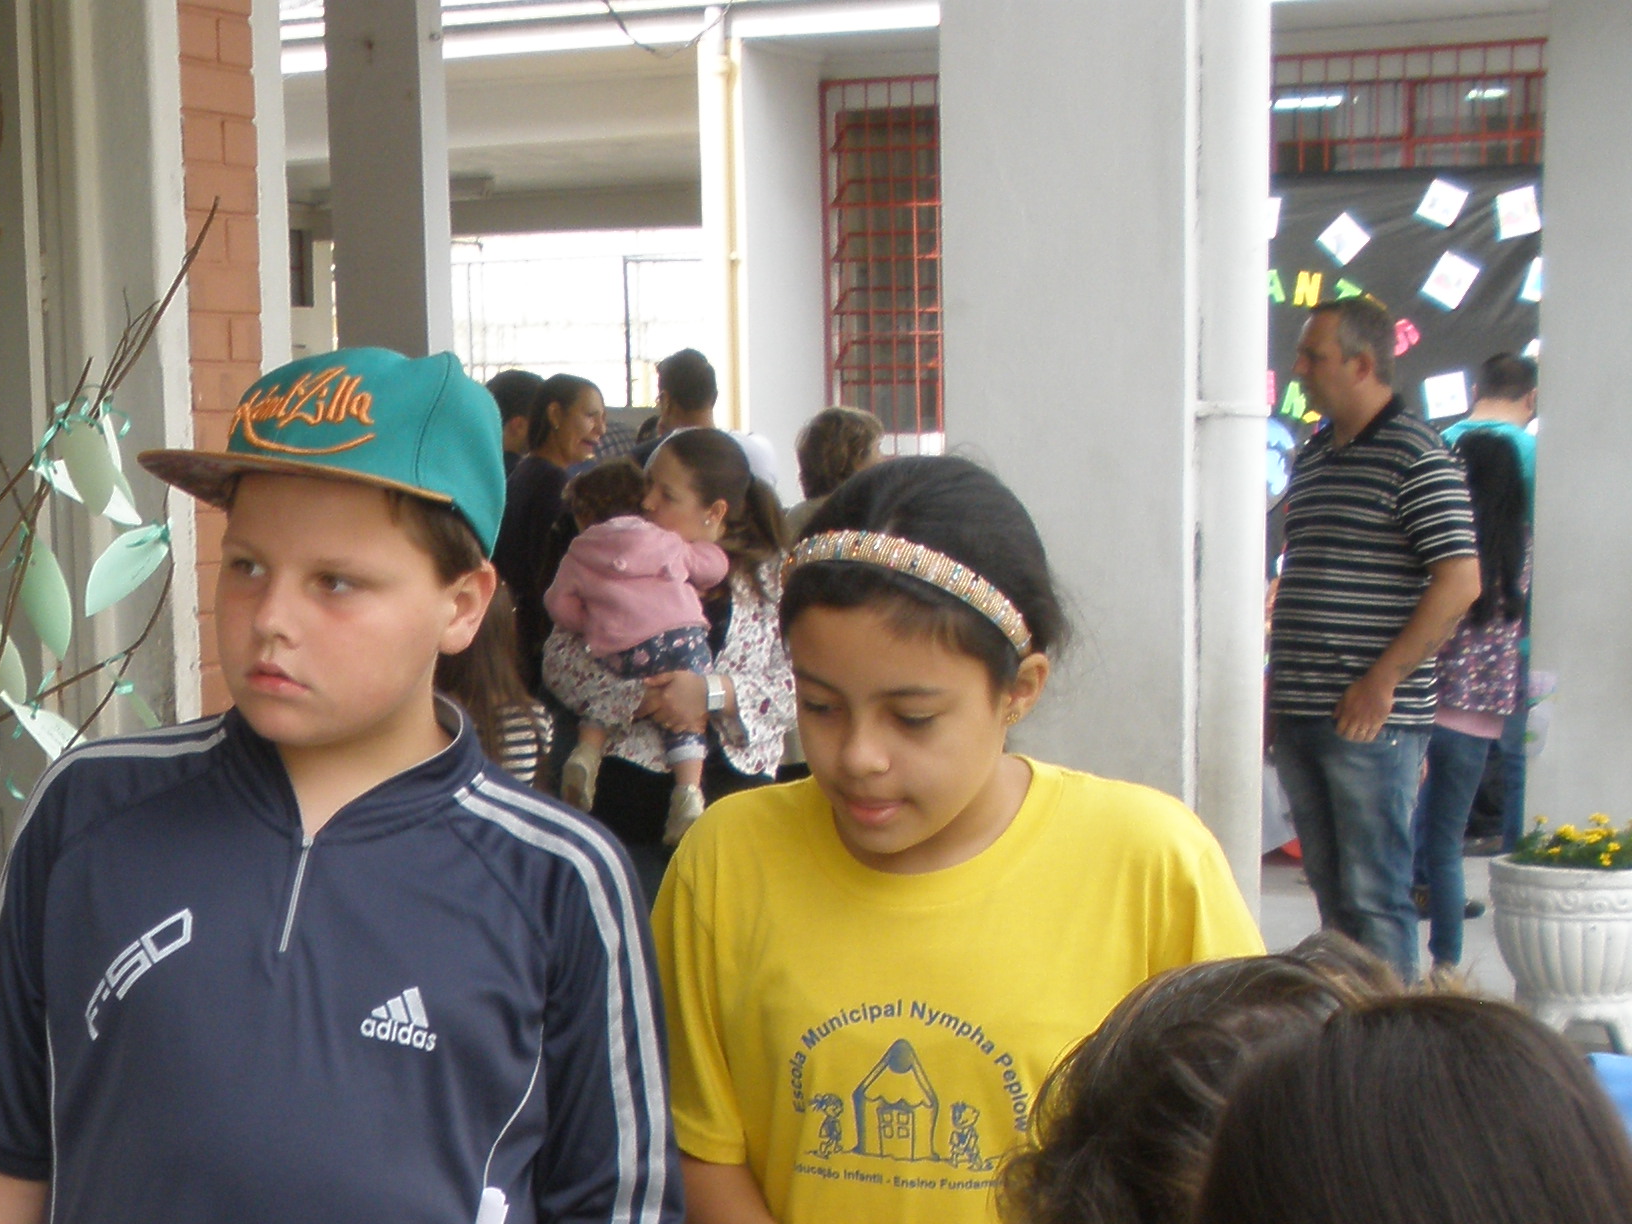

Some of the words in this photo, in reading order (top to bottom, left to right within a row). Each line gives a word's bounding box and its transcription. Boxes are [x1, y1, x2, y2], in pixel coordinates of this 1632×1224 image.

[360, 1017, 437, 1052] adidas
[789, 1051, 807, 1113] Escola
[801, 1000, 902, 1050] Municipal
[910, 1001, 995, 1055] Nympha
[994, 1053, 1028, 1132] Peplow
[893, 1176, 936, 1189] Ensino
